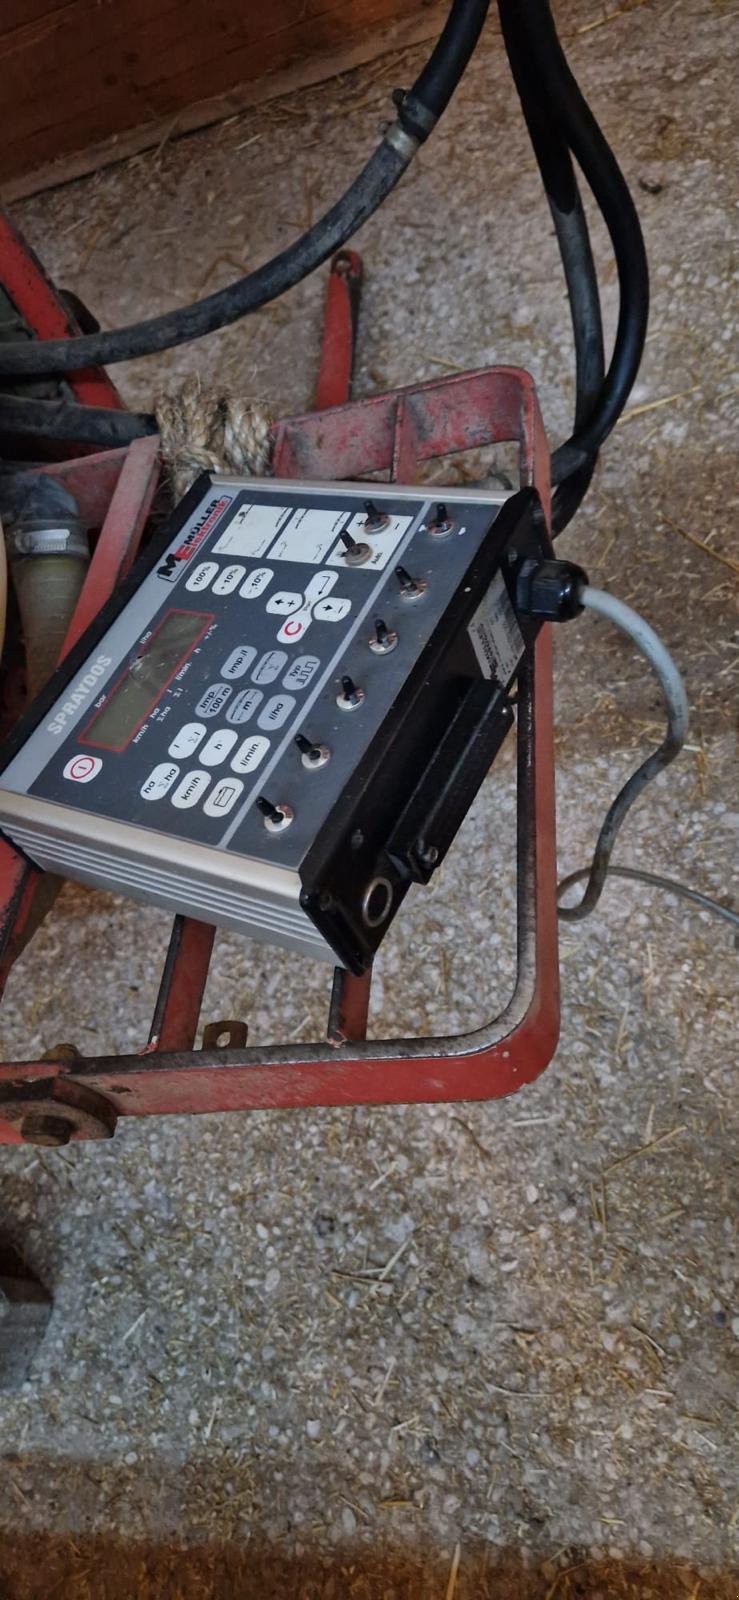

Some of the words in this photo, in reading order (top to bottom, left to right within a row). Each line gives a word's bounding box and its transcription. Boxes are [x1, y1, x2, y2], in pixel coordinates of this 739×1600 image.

[184, 499, 223, 546] MÜLLER
[193, 566, 212, 586] 100%
[284, 621, 303, 636] C
[47, 655, 112, 735] SPRAYDOS
[209, 697, 223, 714] 100
[143, 781, 156, 794] ha
[181, 776, 201, 801] km/h
